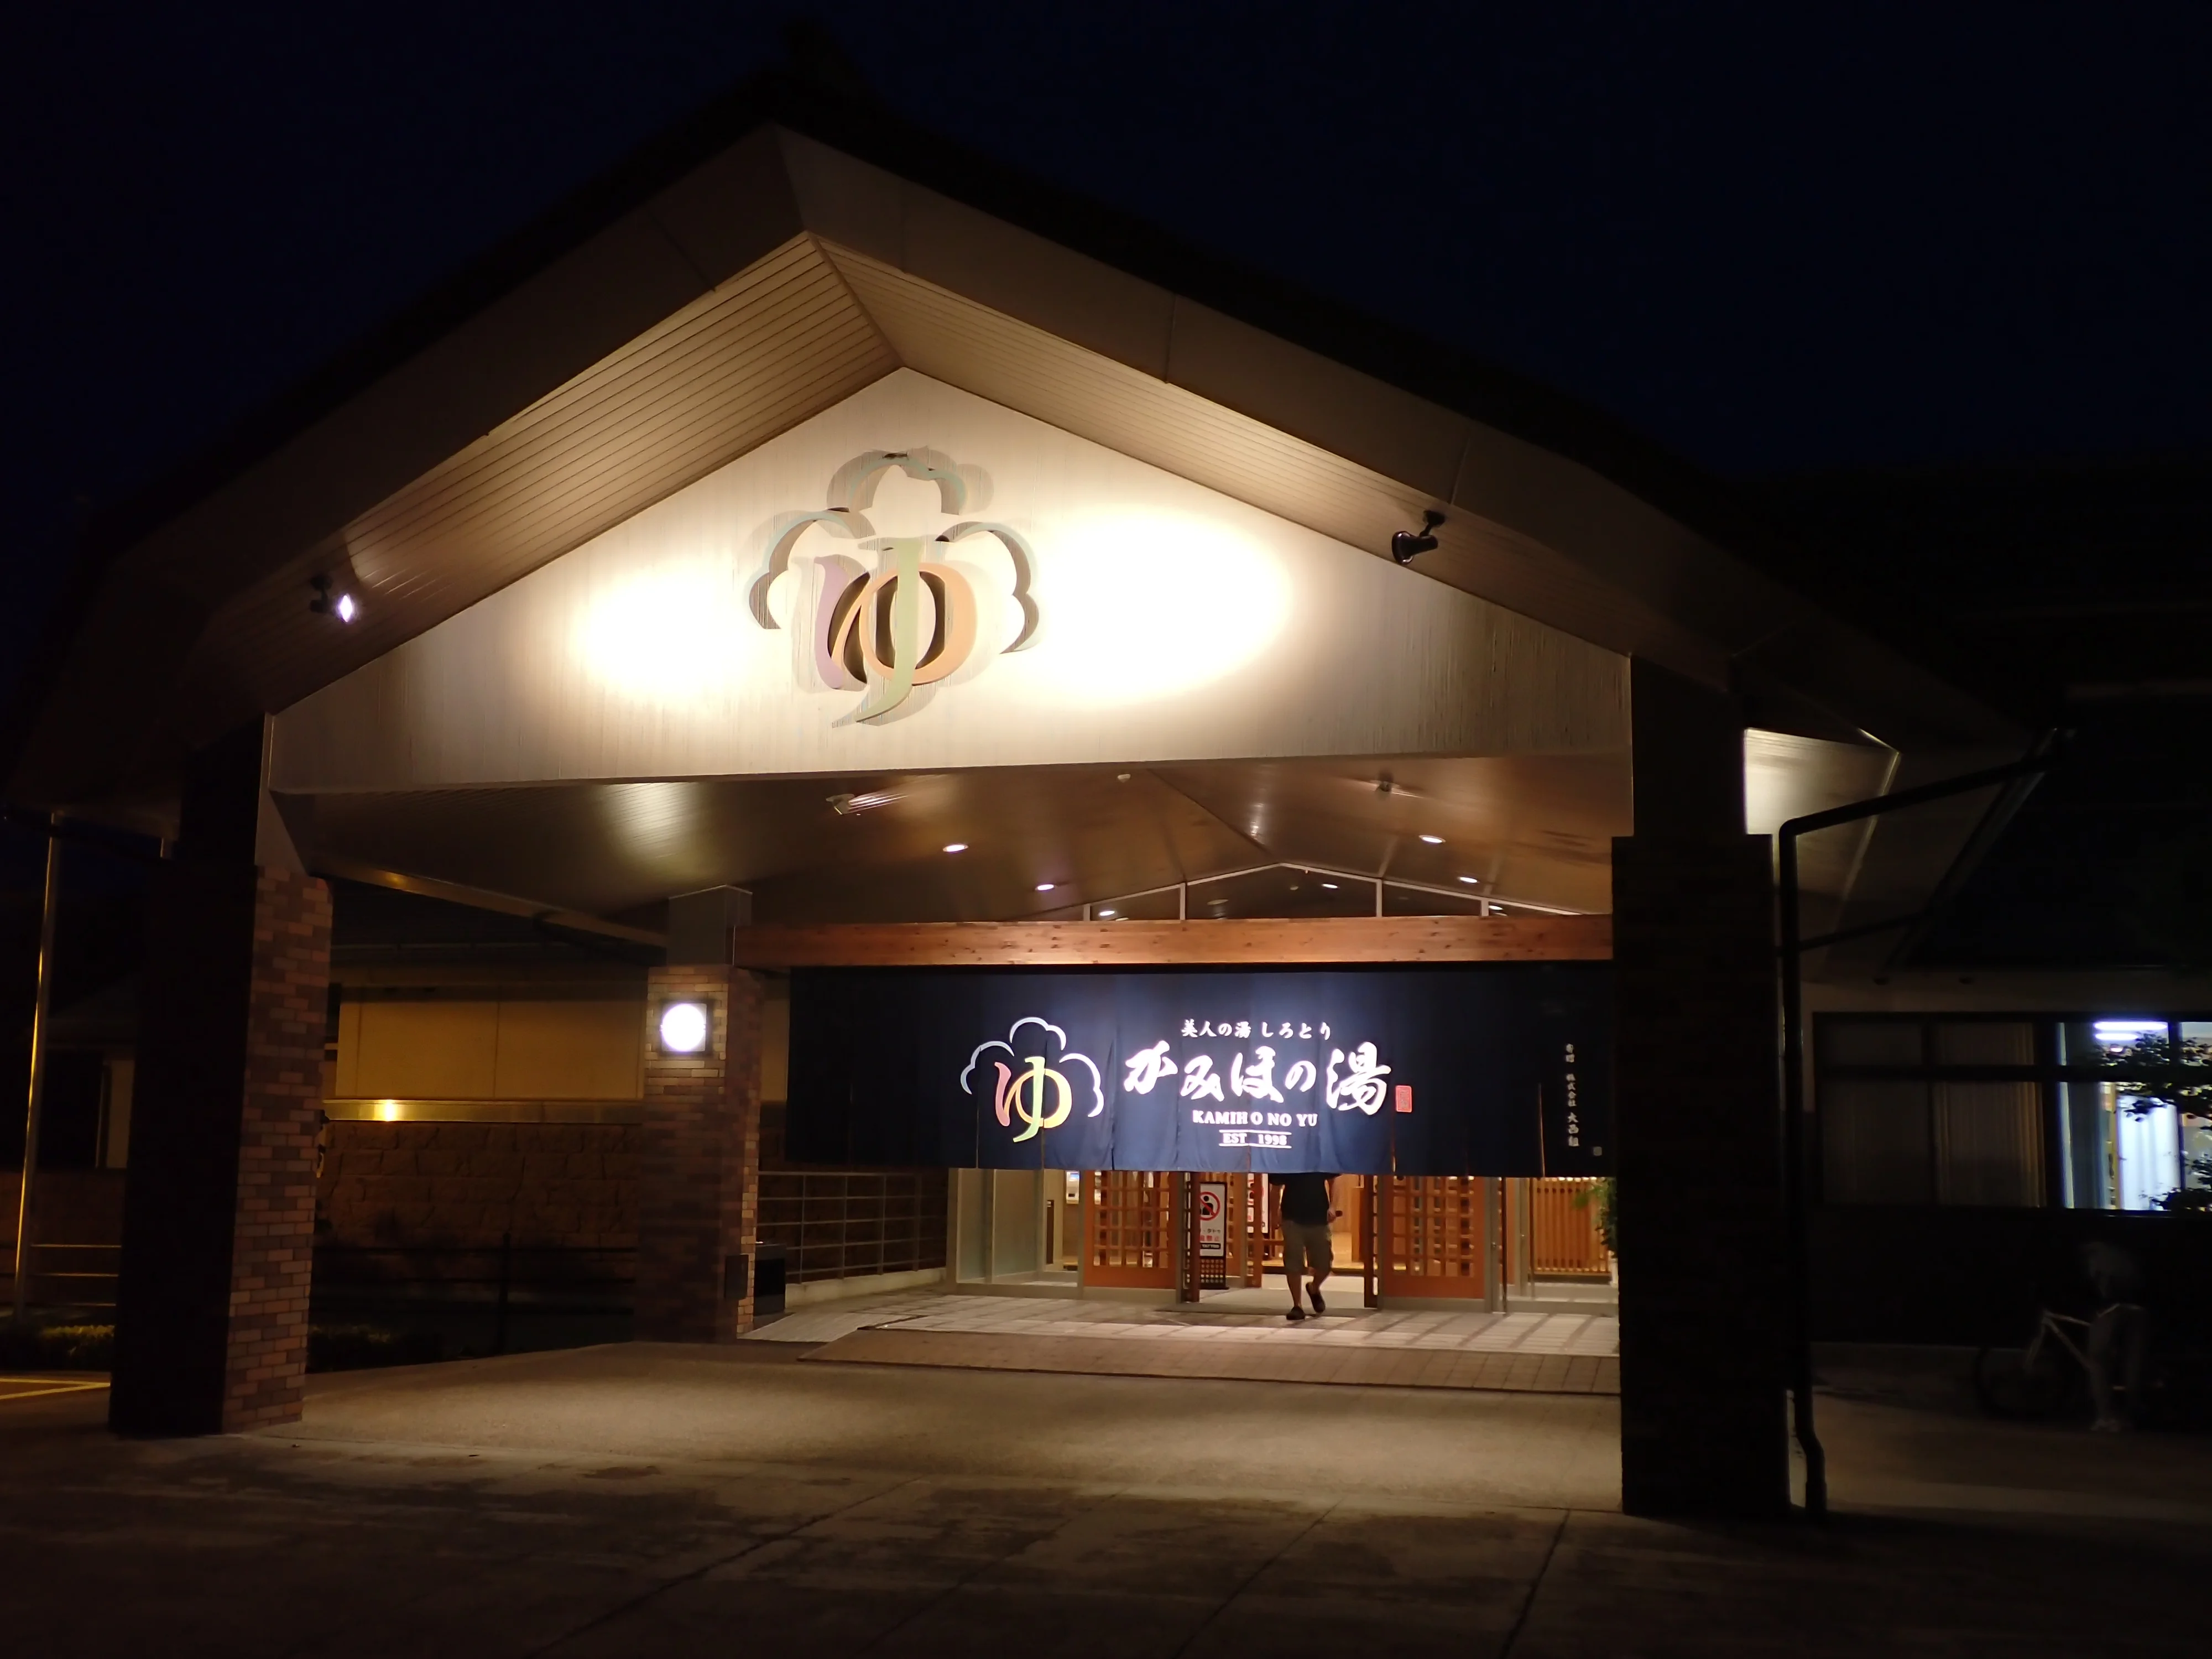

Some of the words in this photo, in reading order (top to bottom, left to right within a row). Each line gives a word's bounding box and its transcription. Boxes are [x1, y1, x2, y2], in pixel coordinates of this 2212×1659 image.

[814, 537, 977, 723] ゆ
[1181, 1019, 1251, 1038] 美人の湯
[1261, 1022, 1331, 1040] しろとり
[994, 1056, 1072, 1142] ゆ
[1124, 1040, 1391, 1115] かみほの湯
[1223, 1133, 1248, 1144] EST
[1258, 1134, 1287, 1145] 1998
[1267, 1112, 1292, 1126] NO
[1296, 1114, 1318, 1126] YU
